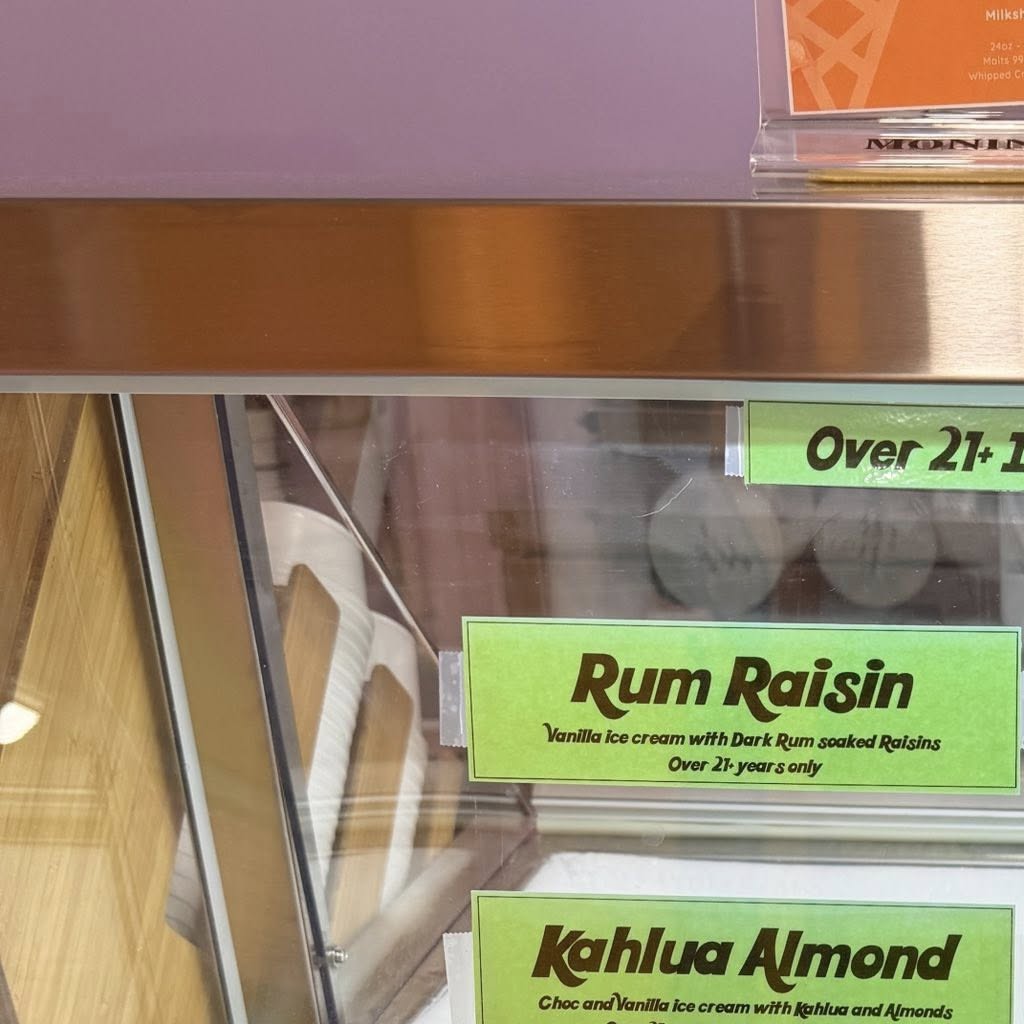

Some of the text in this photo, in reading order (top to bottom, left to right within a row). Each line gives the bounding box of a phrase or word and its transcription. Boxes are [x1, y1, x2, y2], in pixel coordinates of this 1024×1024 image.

[983, 56, 1009, 65] Malts
[968, 70, 1011, 81] Whipped
[807, 426, 923, 471] Over
[929, 426, 993, 471] 21+
[571, 653, 913, 723] Rum Raisin
[543, 723, 941, 753] Vanilla ice cream with Dark Rum soaked Raisins
[668, 756, 823, 777] Over 21+ years only
[531, 925, 962, 993] Kahlua Almond
[539, 992, 953, 1021] Choc and Vanilla ice cream with Kahlua and Almonds
